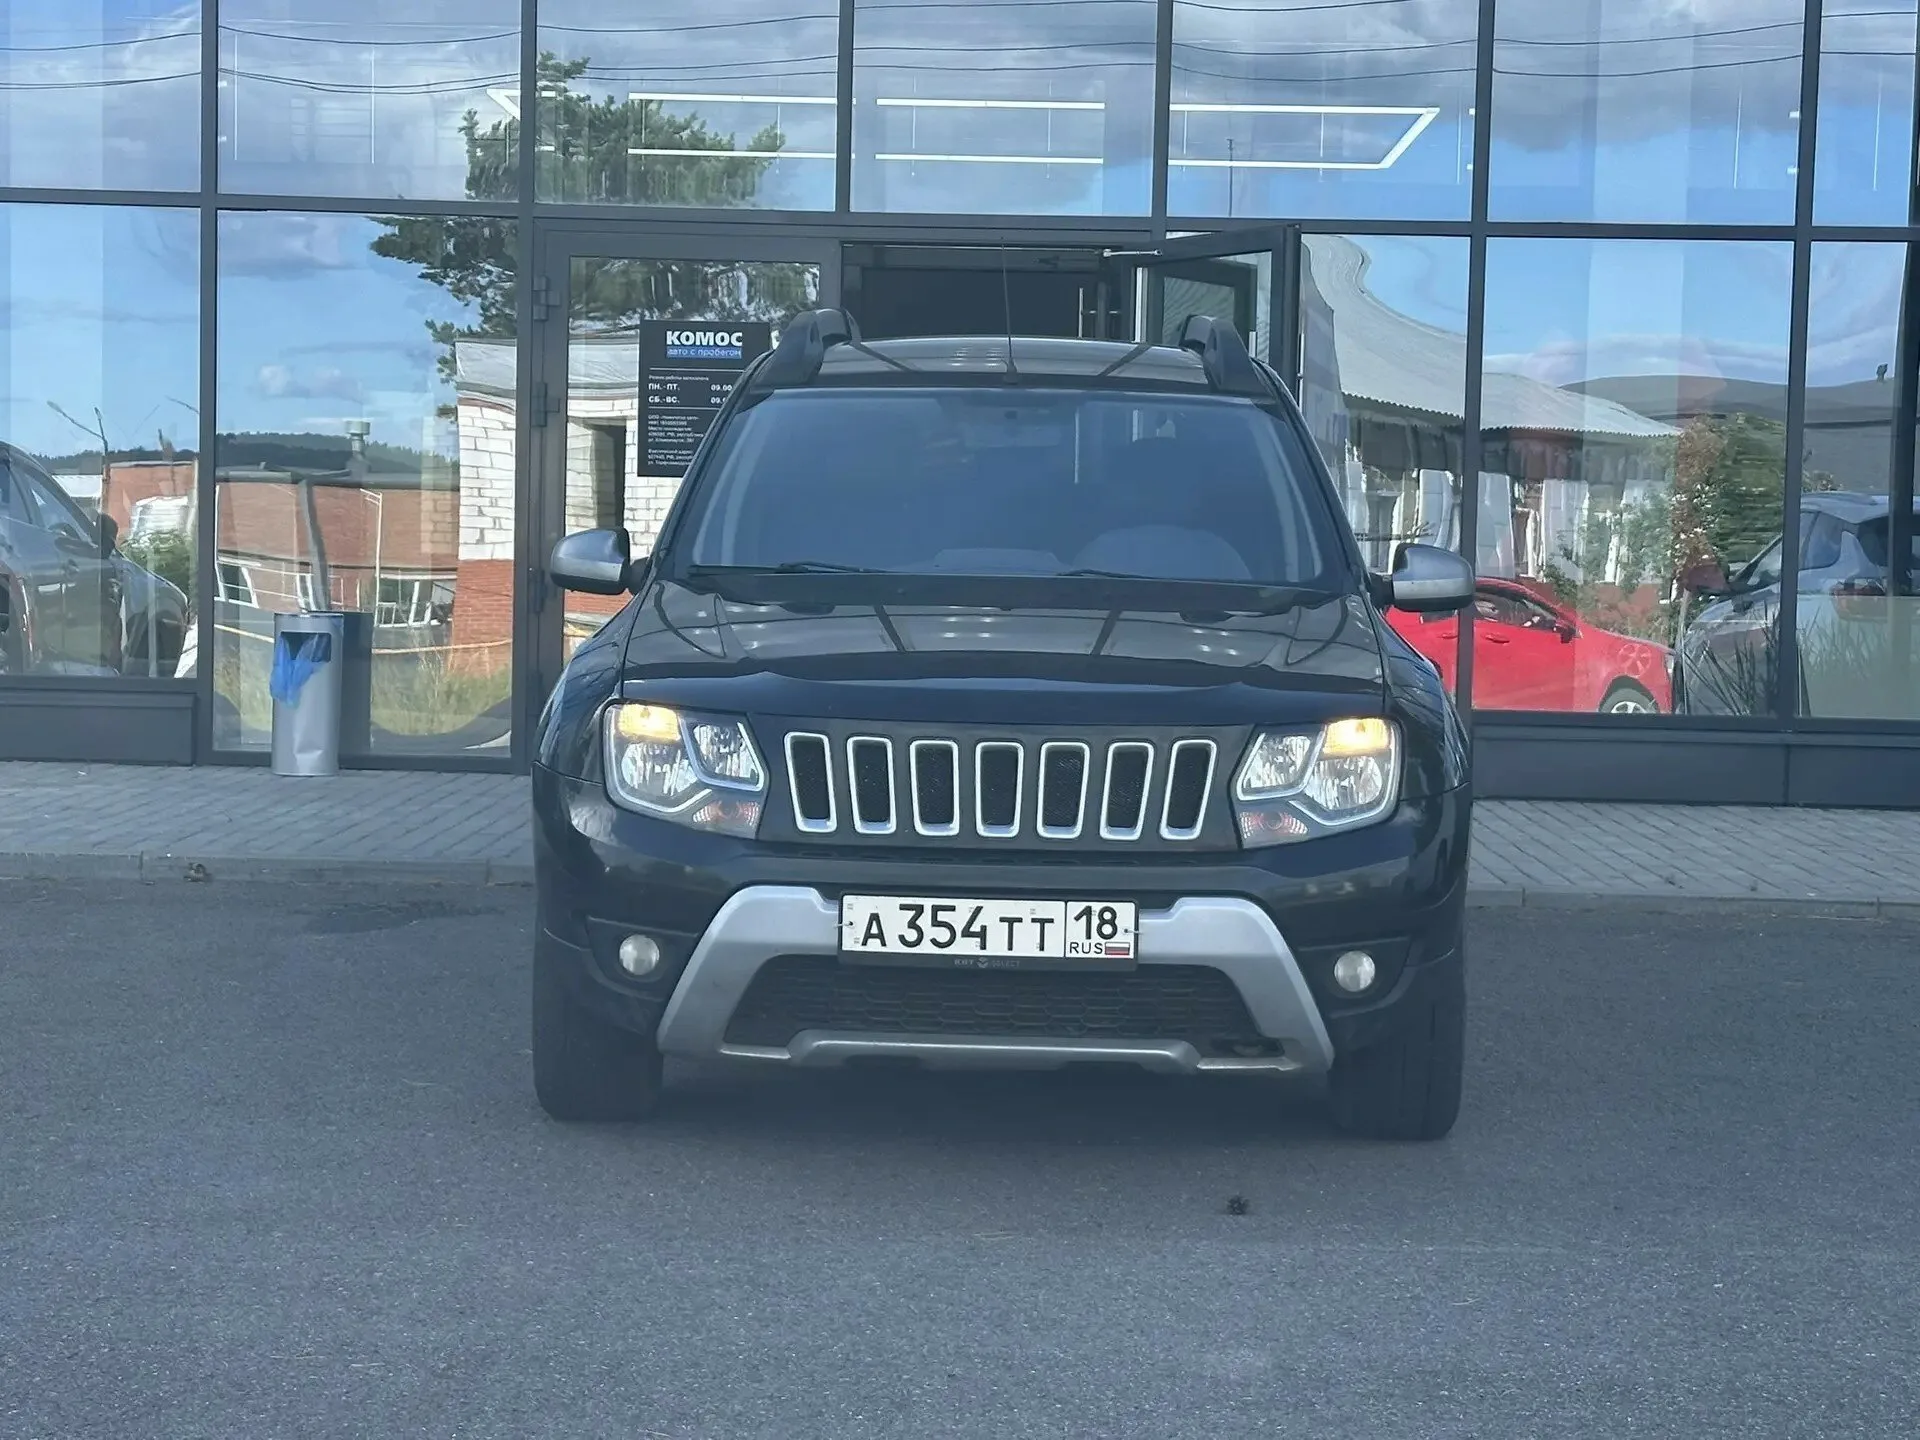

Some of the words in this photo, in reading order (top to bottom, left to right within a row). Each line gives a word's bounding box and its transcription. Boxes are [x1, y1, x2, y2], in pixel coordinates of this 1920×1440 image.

[666, 331, 743, 346] КОМОС
[667, 348, 688, 356] авто
[697, 348, 742, 357] пробегом
[1073, 905, 1118, 940] 18
[1069, 942, 1103, 954] RUS
